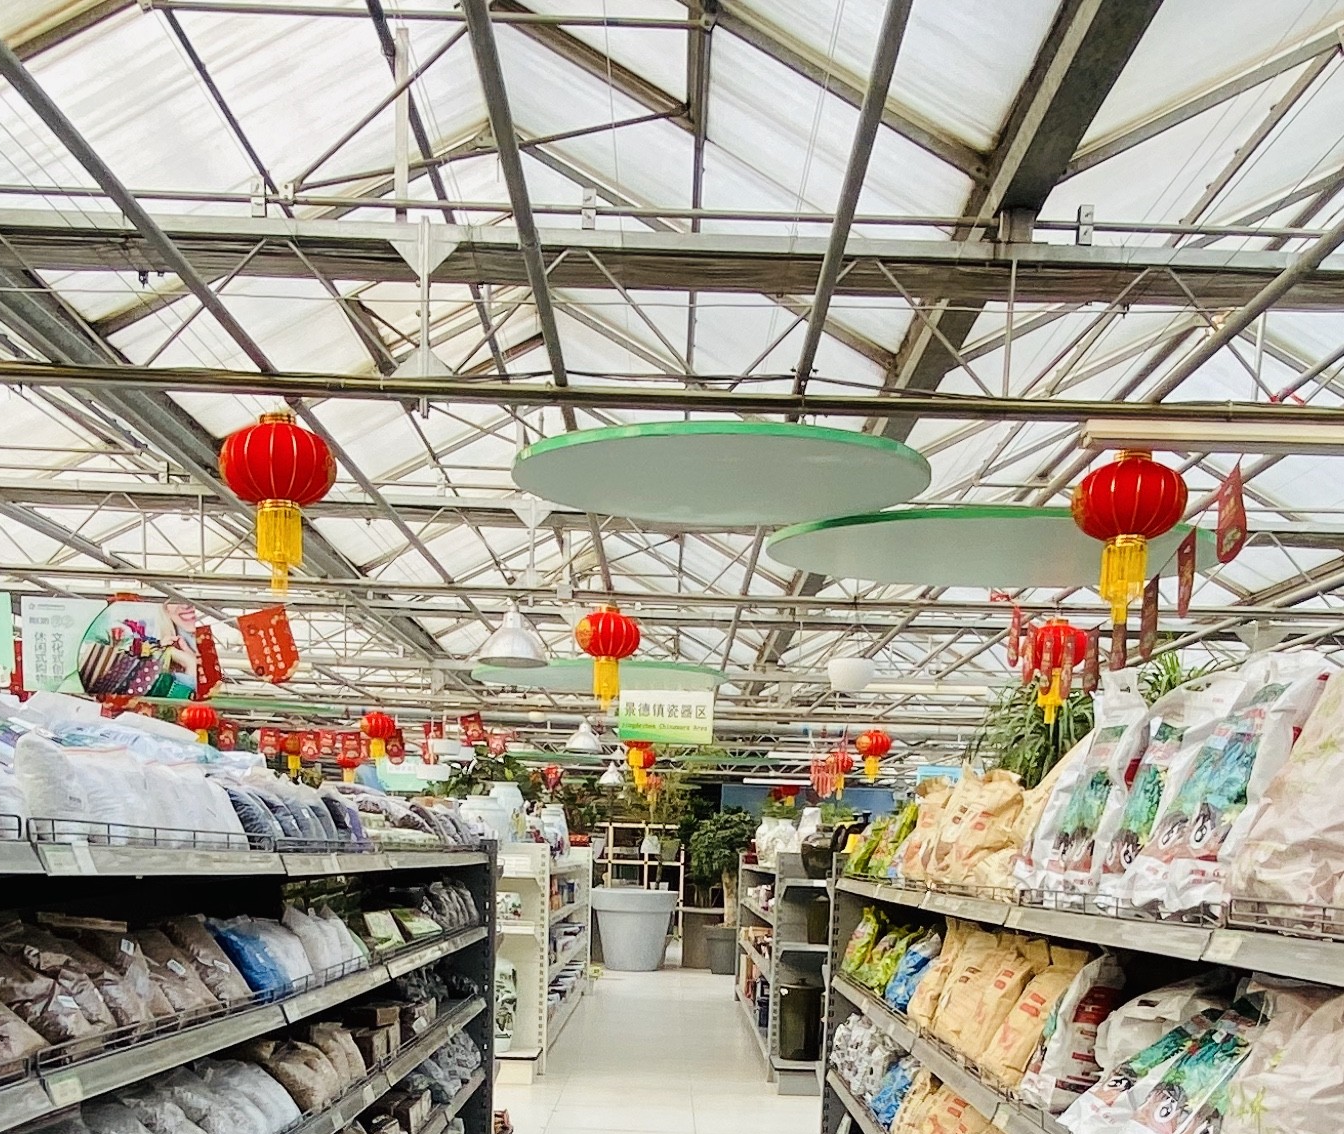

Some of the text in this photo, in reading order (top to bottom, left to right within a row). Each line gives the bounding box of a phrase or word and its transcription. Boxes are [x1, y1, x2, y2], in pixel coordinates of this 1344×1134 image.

[624, 701, 707, 719] 景德镇瓷器区
